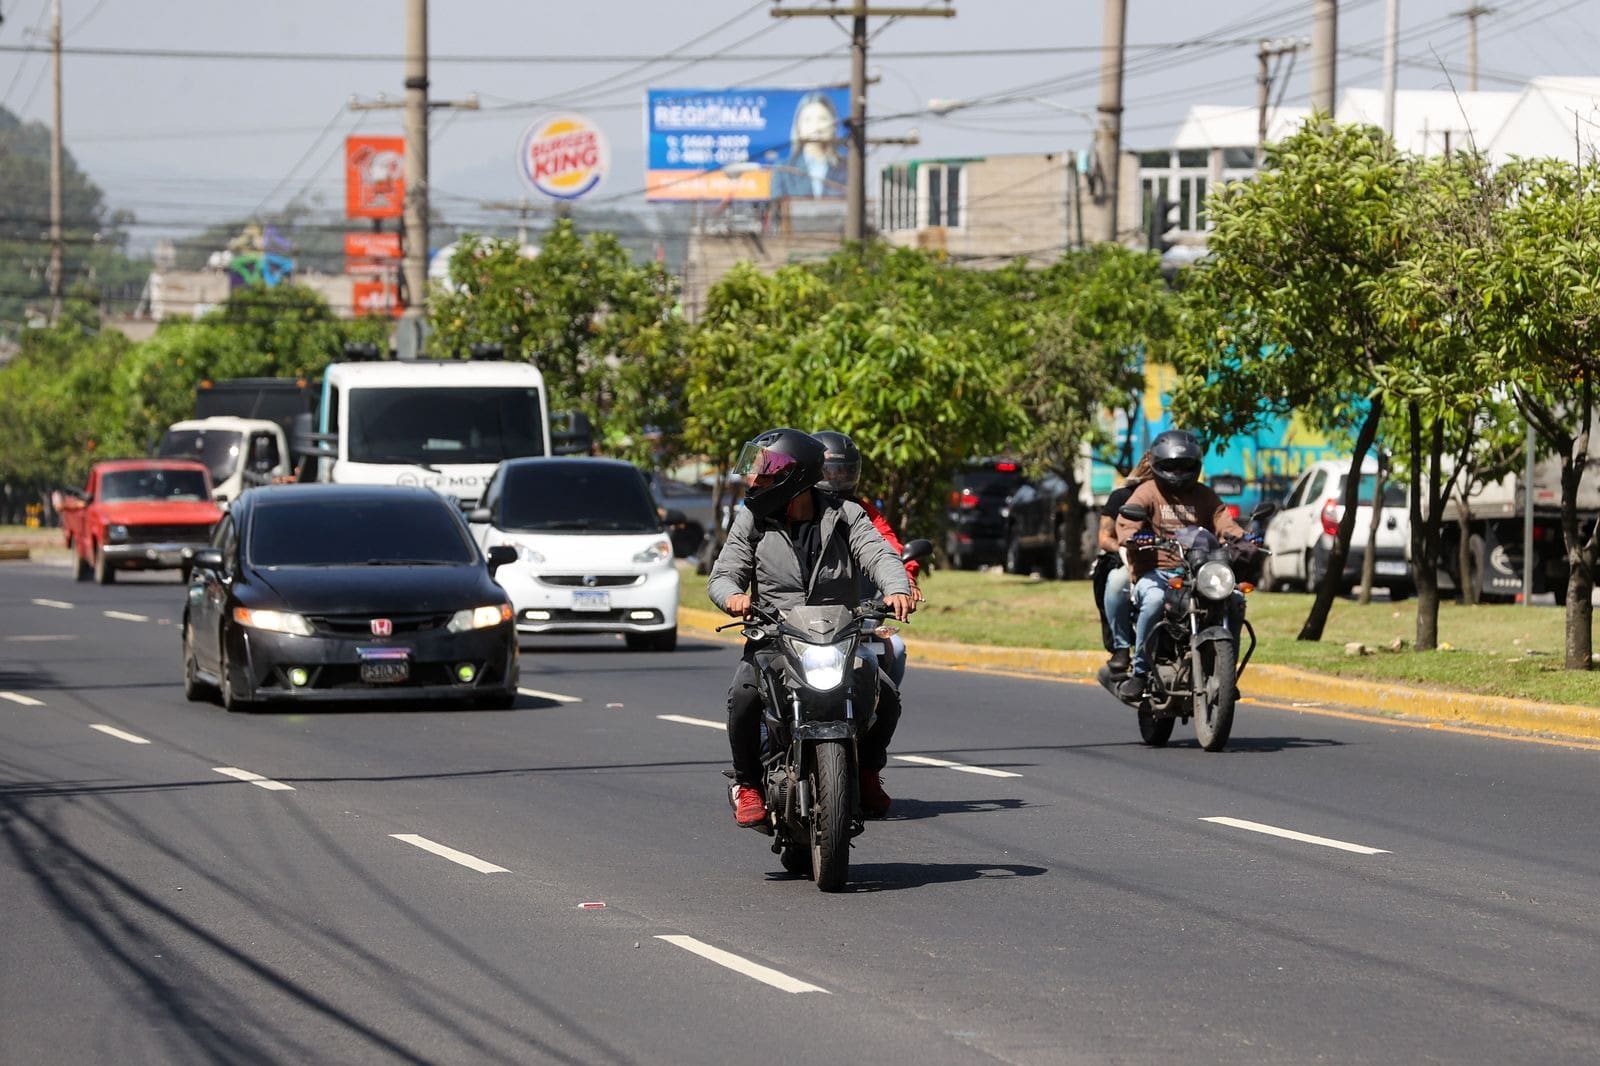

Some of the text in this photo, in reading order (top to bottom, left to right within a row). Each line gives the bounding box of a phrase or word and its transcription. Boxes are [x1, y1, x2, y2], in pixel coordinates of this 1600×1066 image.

[654, 105, 765, 124] REGIONAL
[531, 130, 596, 158] BURGER
[533, 147, 599, 180] KING
